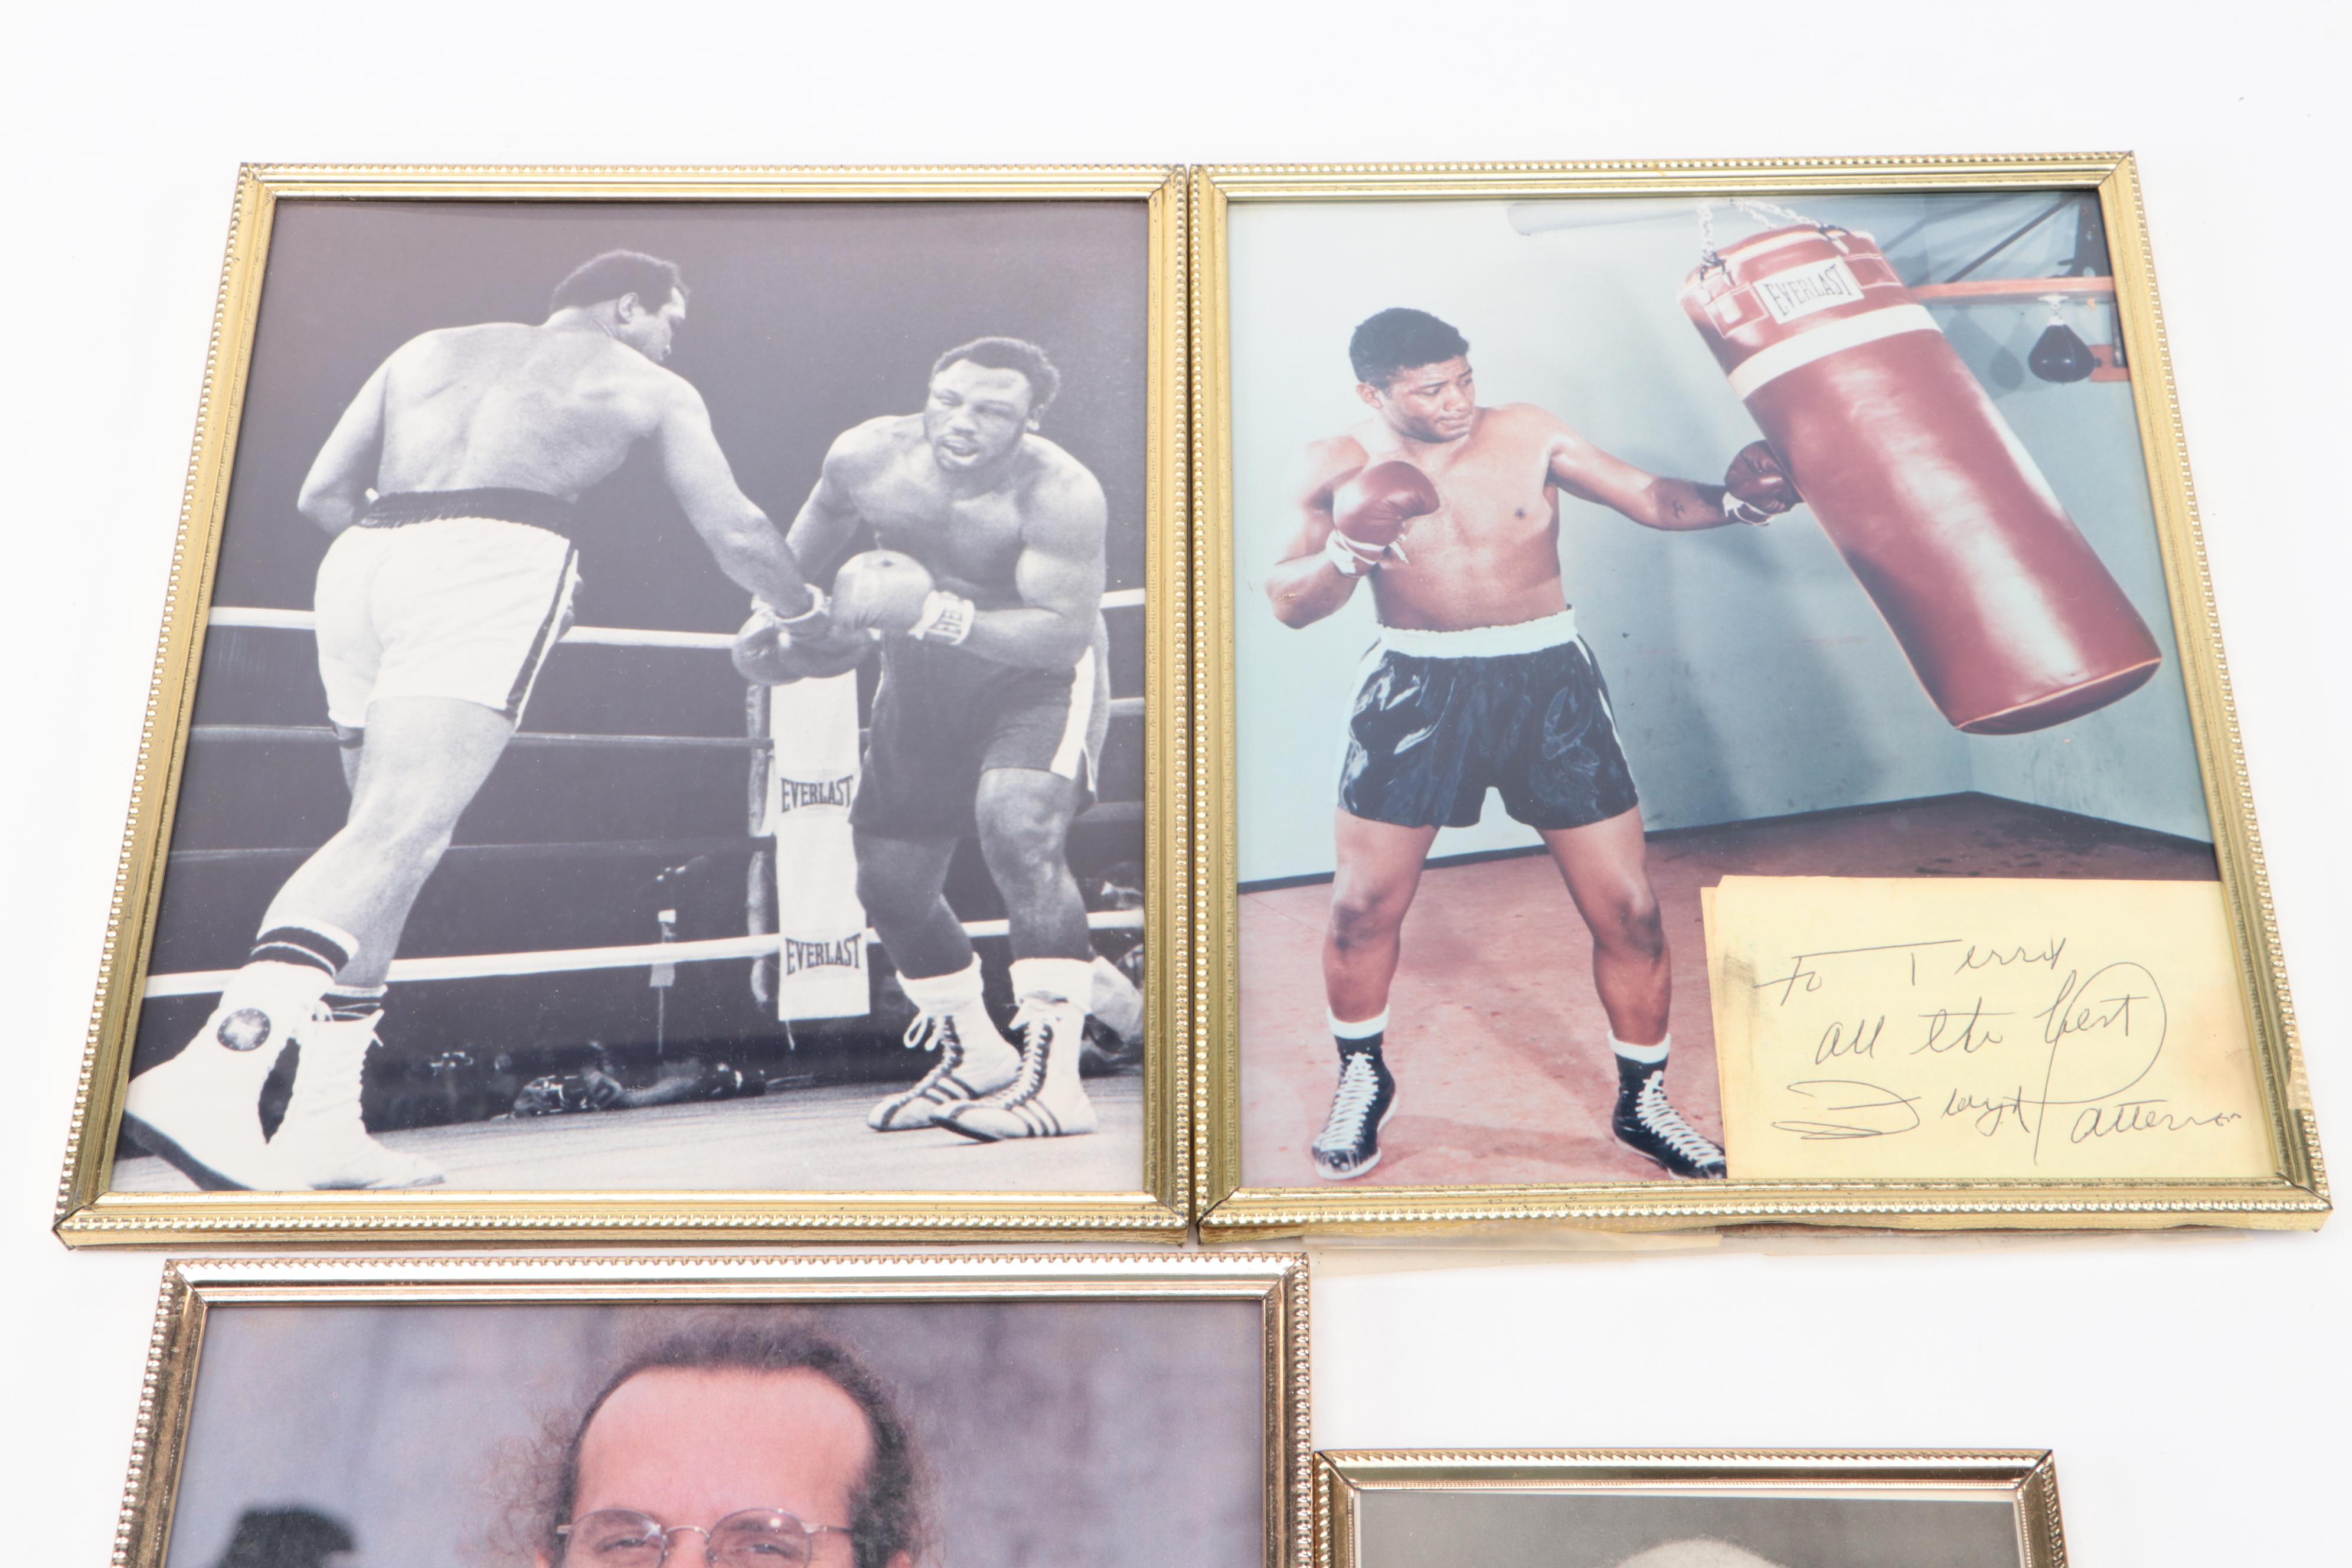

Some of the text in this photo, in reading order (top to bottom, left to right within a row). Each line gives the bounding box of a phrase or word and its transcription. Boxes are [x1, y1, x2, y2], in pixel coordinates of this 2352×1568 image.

[1763, 264, 1852, 316] EVERLAST
[780, 775, 854, 813] EVERLAST
[785, 933, 861, 975] EVERLAST
[1814, 1014, 1886, 1066] all
